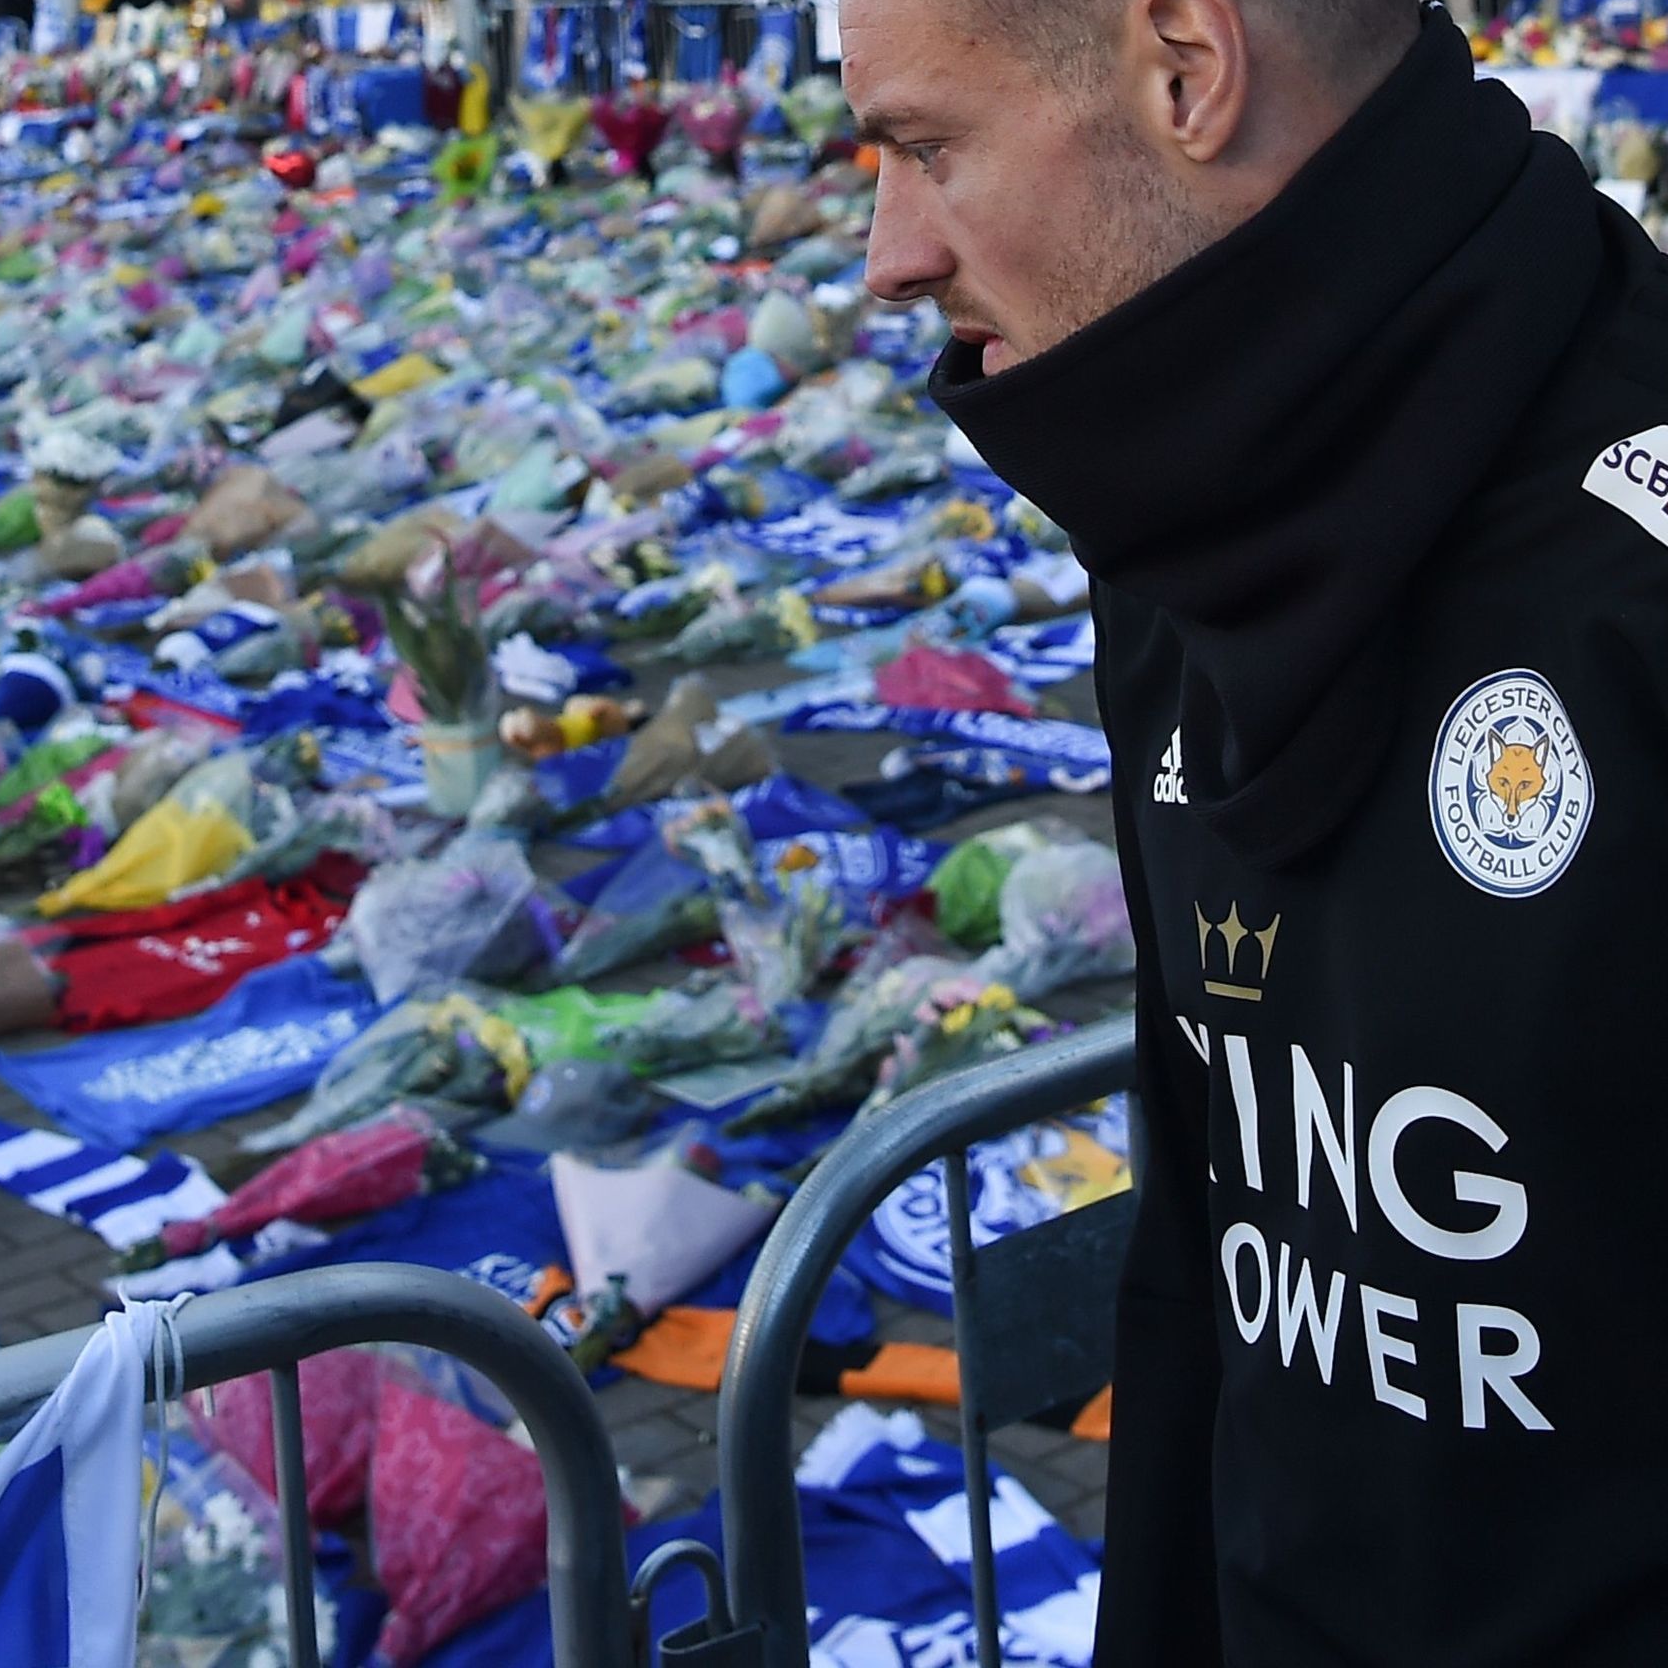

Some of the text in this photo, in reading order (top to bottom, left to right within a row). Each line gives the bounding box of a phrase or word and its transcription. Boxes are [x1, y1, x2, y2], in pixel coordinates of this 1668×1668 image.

[1448, 687, 1582, 781] LEICESTER CITY
[1444, 785, 1581, 878] FOOTBALL CLUB
[1221, 1221, 1556, 1432] OWER
